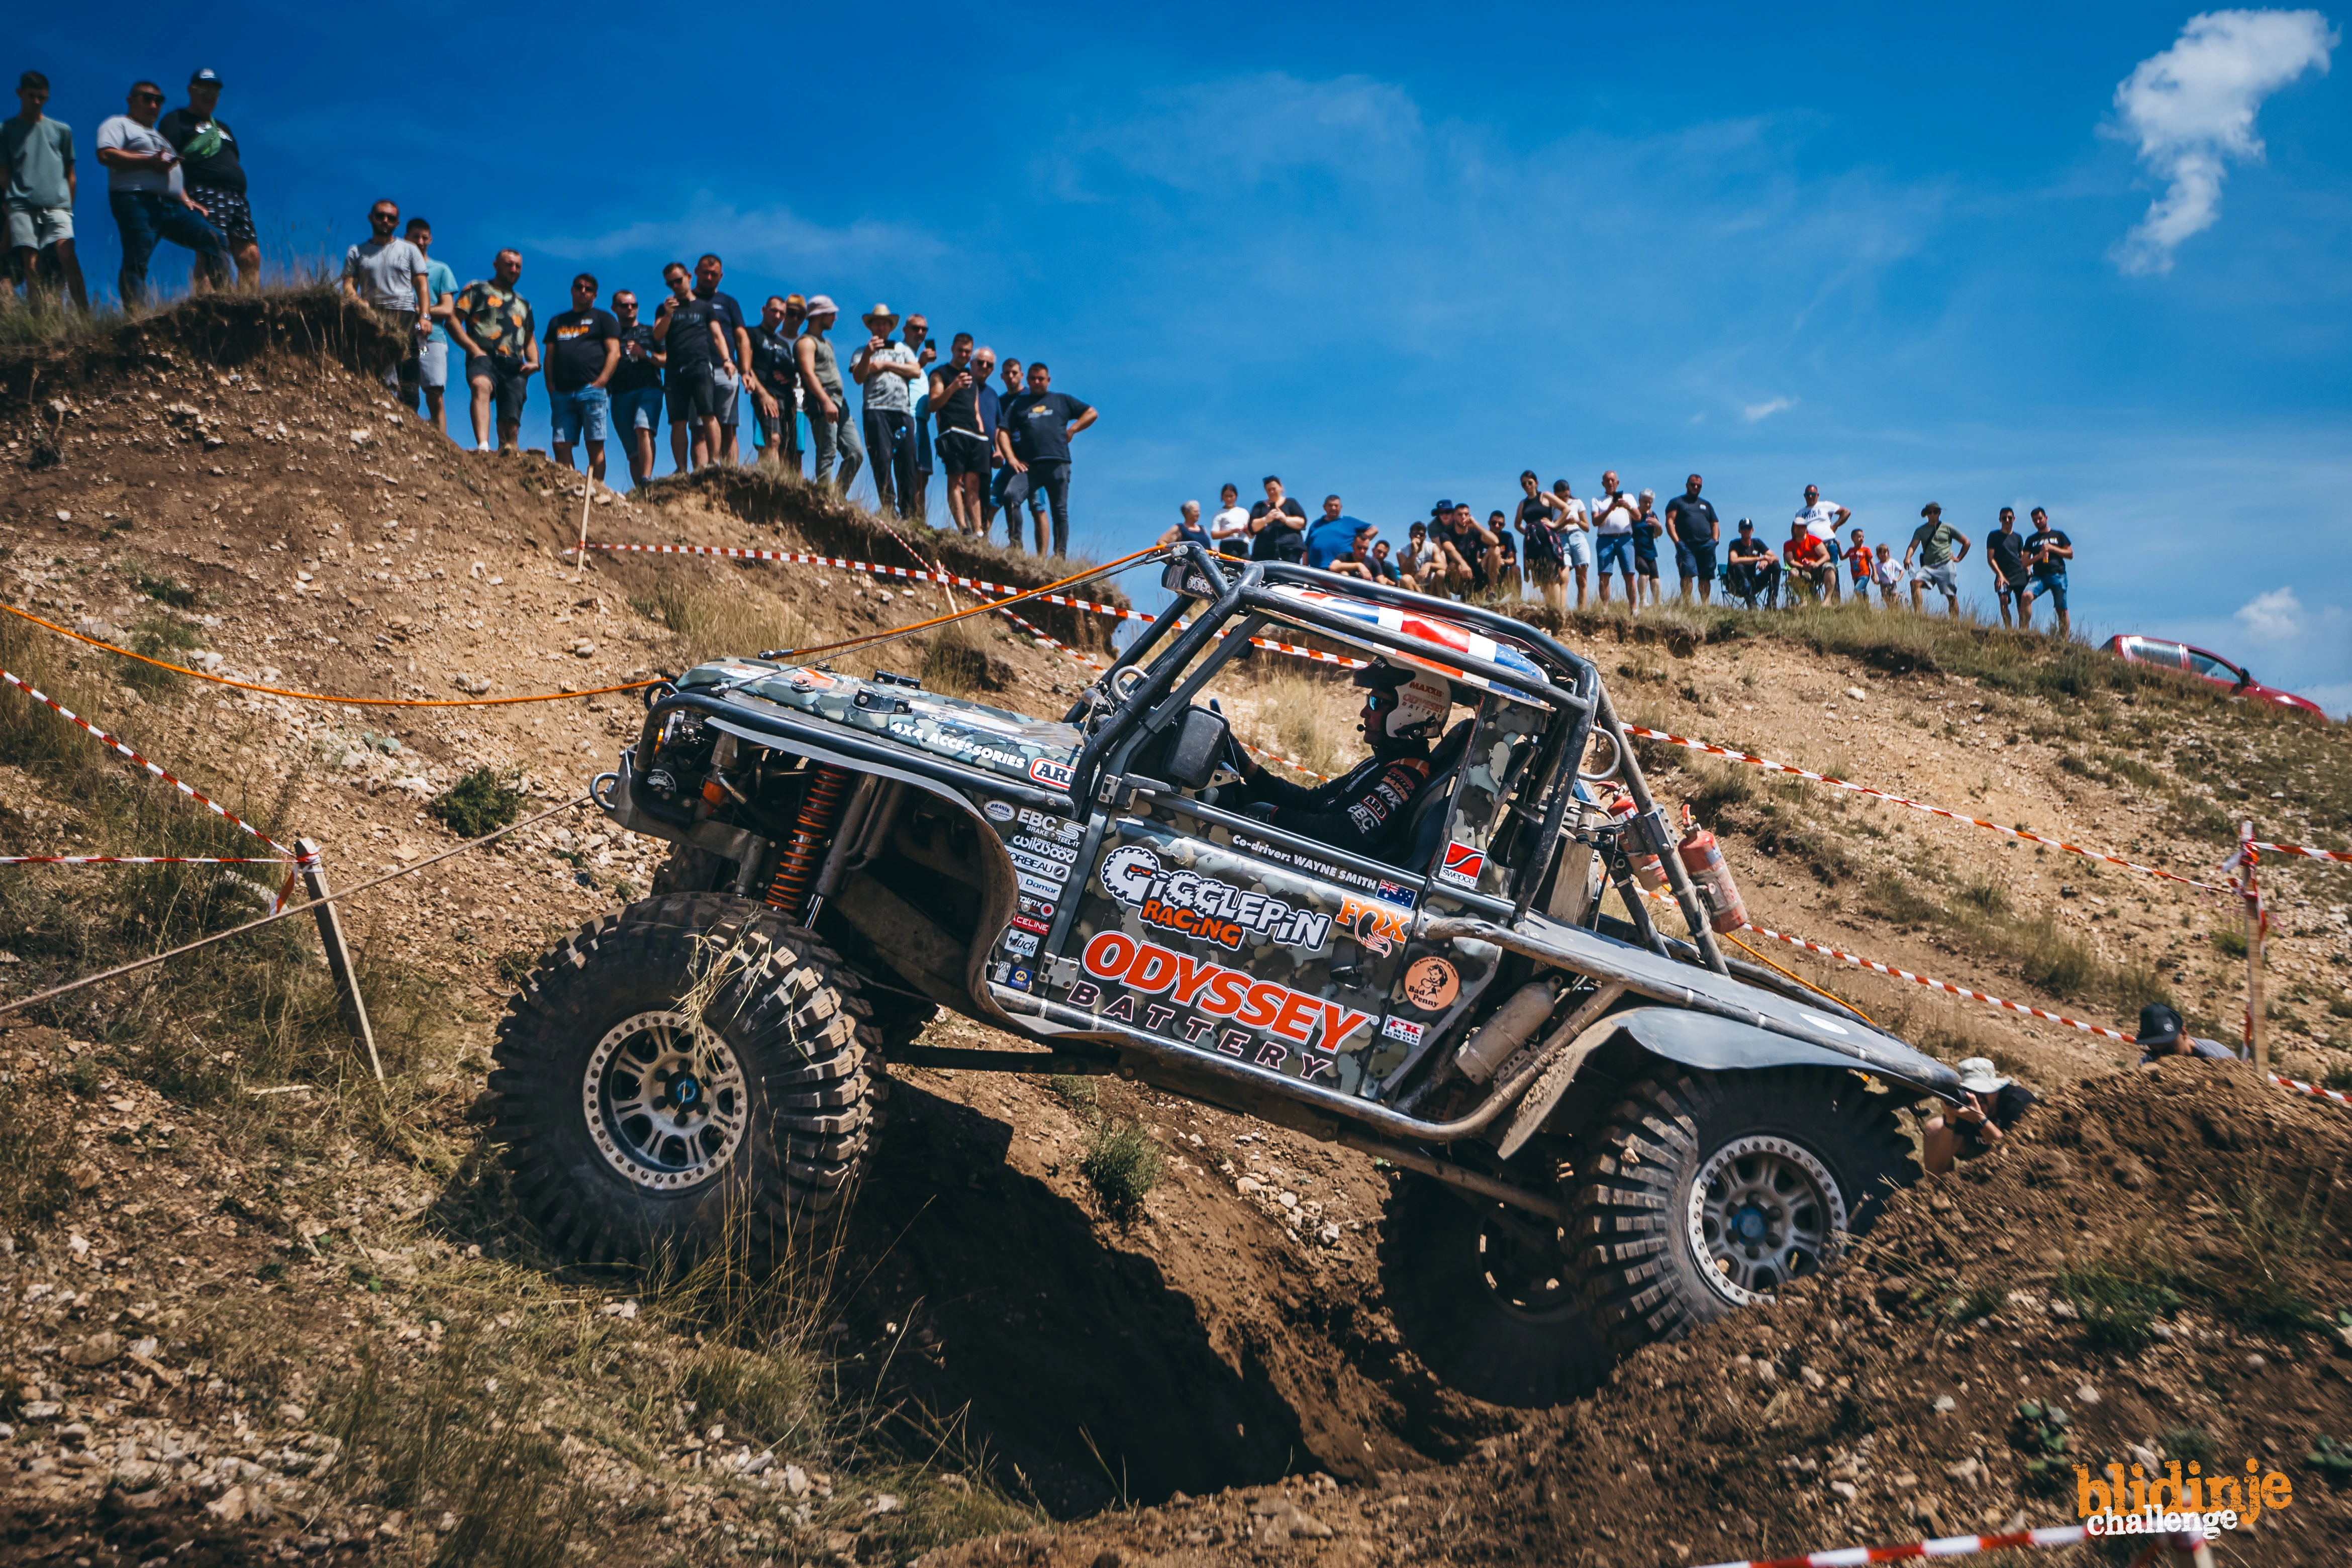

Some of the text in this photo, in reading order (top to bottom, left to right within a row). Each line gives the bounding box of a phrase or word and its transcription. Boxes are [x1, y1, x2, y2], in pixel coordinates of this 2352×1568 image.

[1409, 681, 1444, 698] MAXXIS
[1402, 701, 1441, 718] BATTERY
[890, 722, 924, 739] 4X4
[927, 733, 1026, 769] ACCESSORIES
[990, 804, 1010, 813] BRANIK
[1017, 808, 1057, 831] EBC
[1347, 805, 1374, 830] EBC
[1351, 814, 1365, 834] BRAKES
[1026, 825, 1050, 837] BRAKE
[1013, 835, 1078, 863] wilwood
[1051, 843, 1076, 854] BRAKES
[1056, 835, 1080, 848] TEEL-IT
[1007, 850, 1053, 873] ORBEAU
[1232, 835, 1378, 890] Co-driver: WAYNE SMITH
[1442, 869, 1475, 885] swepco
[1025, 878, 1058, 894] Damar
[1014, 916, 1049, 931] CELINE
[1335, 895, 1412, 947] FOX
[1082, 930, 1372, 1055] ODYSSEY
[1408, 985, 1425, 996] Bad
[1412, 994, 1439, 1008] Penny
[1067, 980, 1333, 1080] BATTERY
[1385, 1030, 1417, 1043] ENDS
[1394, 1028, 1419, 1039] ROD
